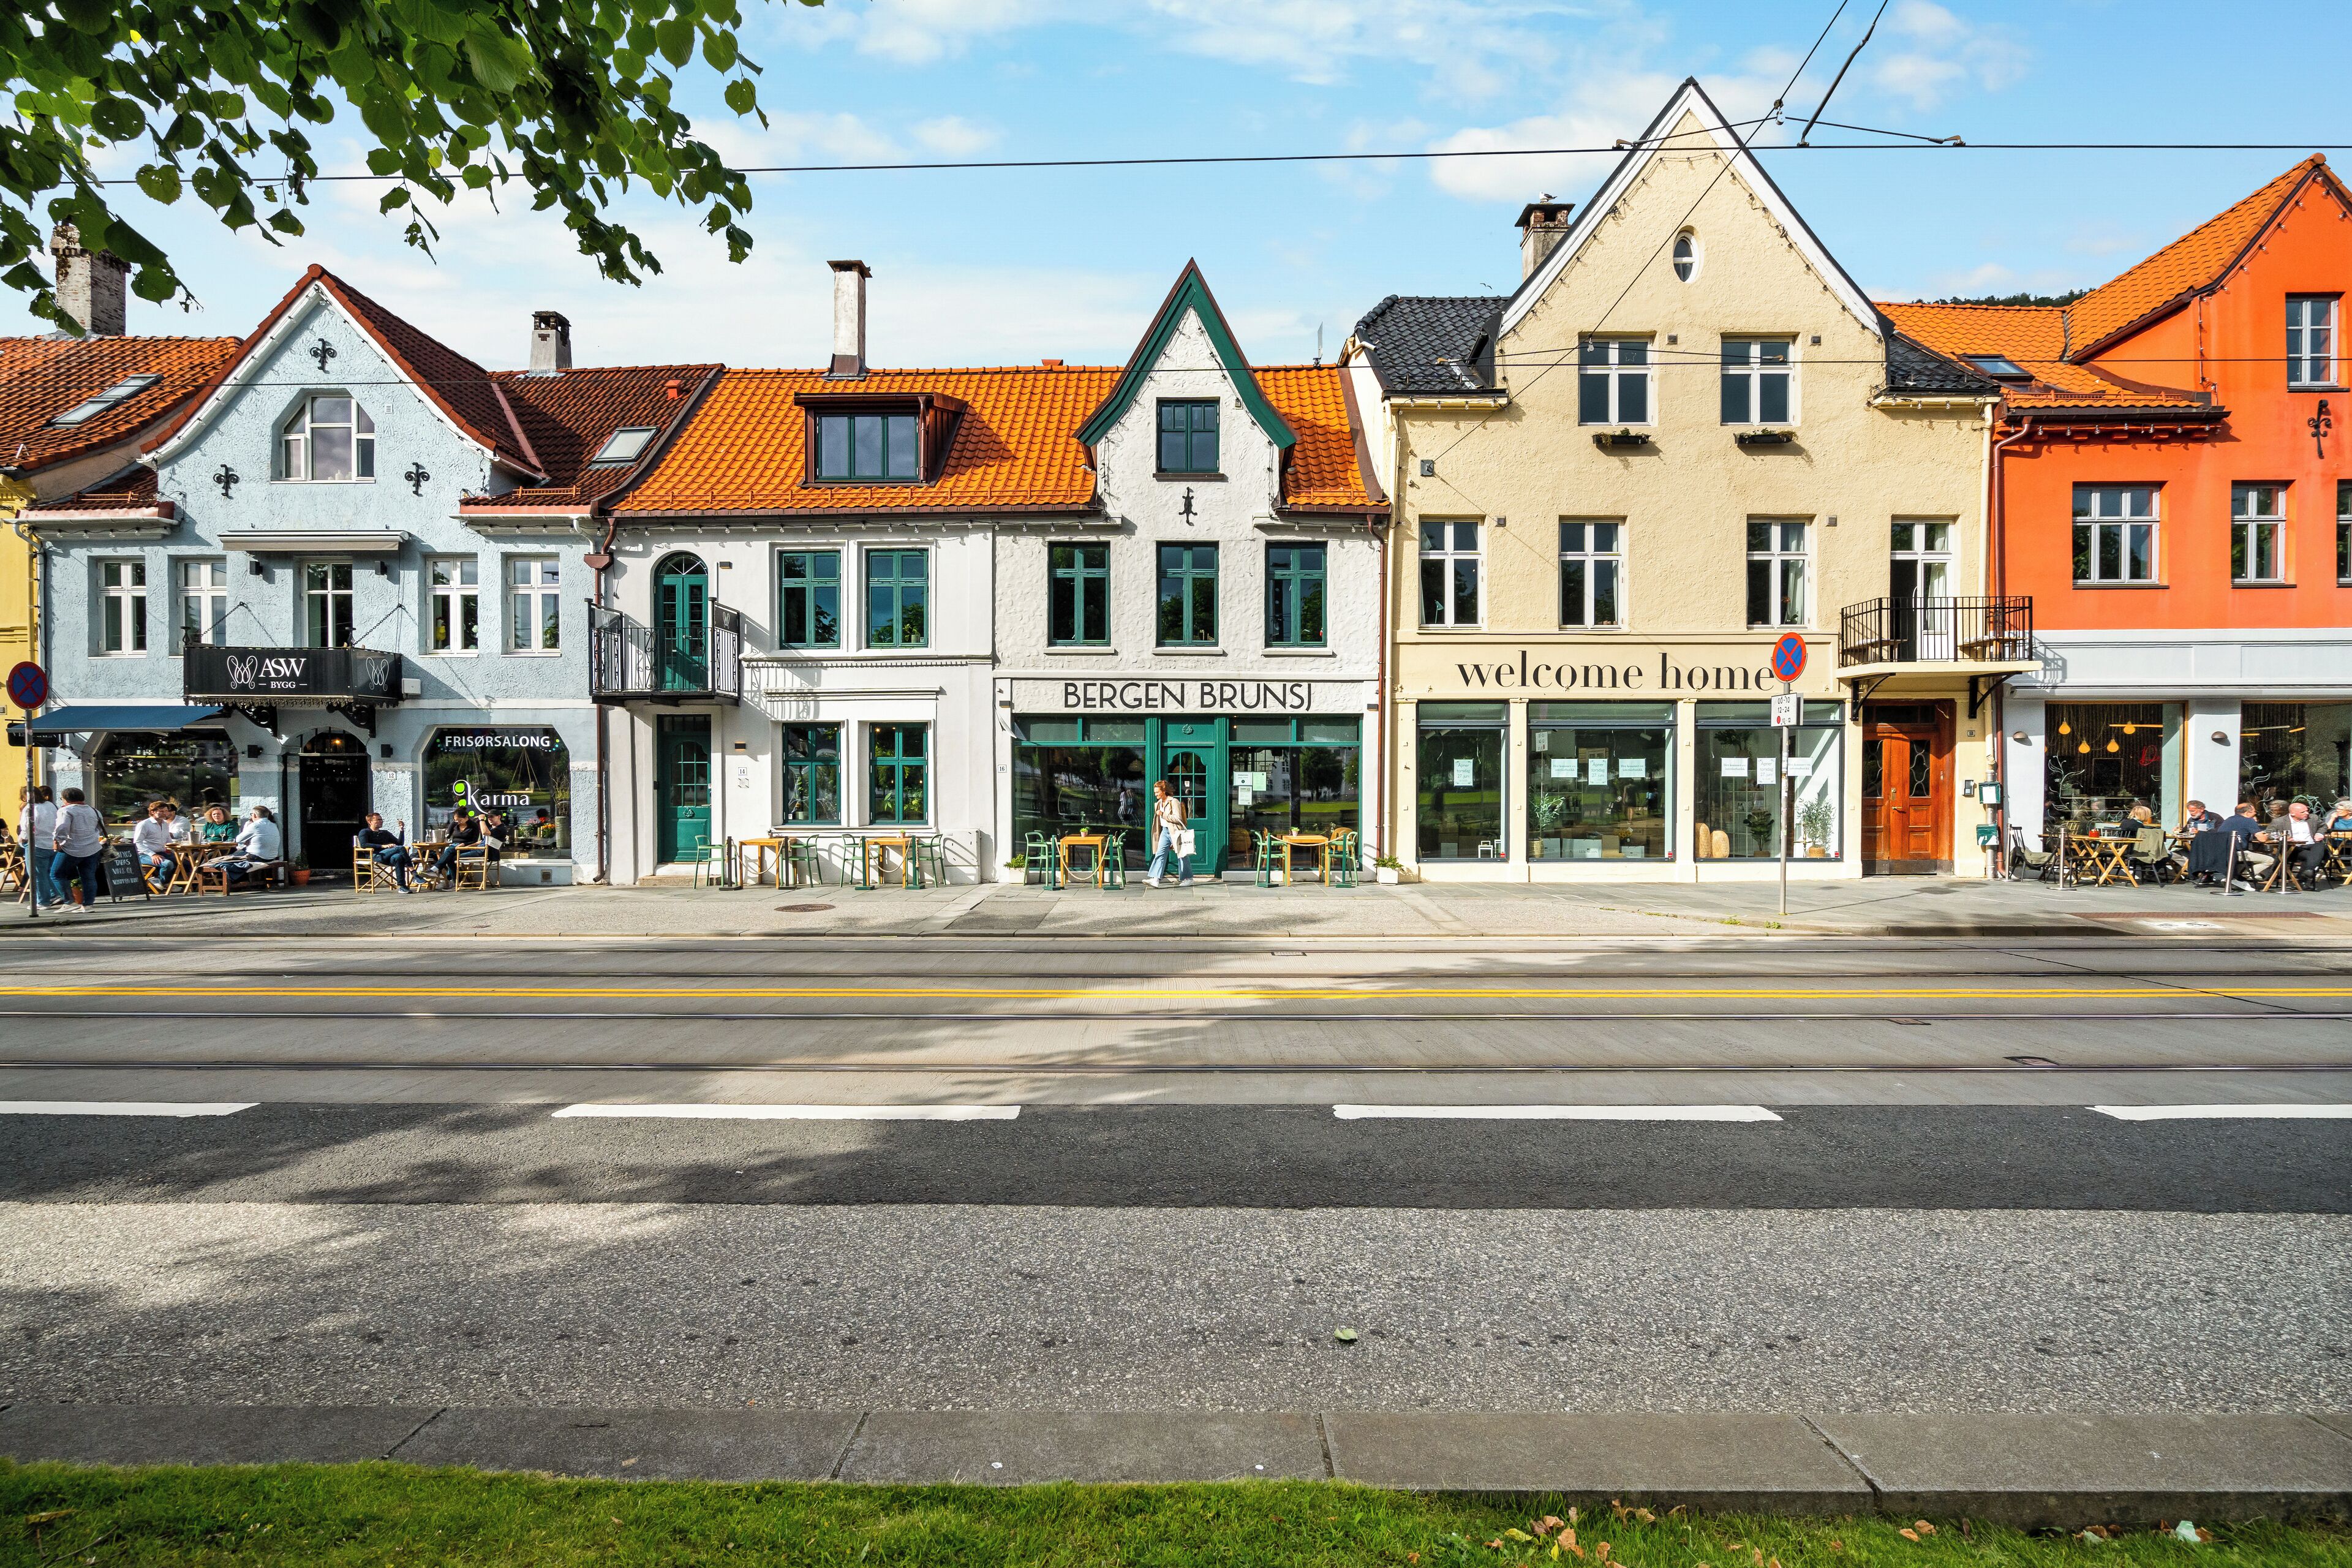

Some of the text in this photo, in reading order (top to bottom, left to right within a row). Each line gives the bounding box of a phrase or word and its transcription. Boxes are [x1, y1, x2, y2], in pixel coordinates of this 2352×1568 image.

[258, 658, 307, 677] ASW
[1455, 650, 1774, 691] welcome home
[1064, 682, 1311, 712] BERGEN BRUNSJ
[445, 736, 550, 747] FRISØRSALONG
[453, 779, 529, 814] Karma
